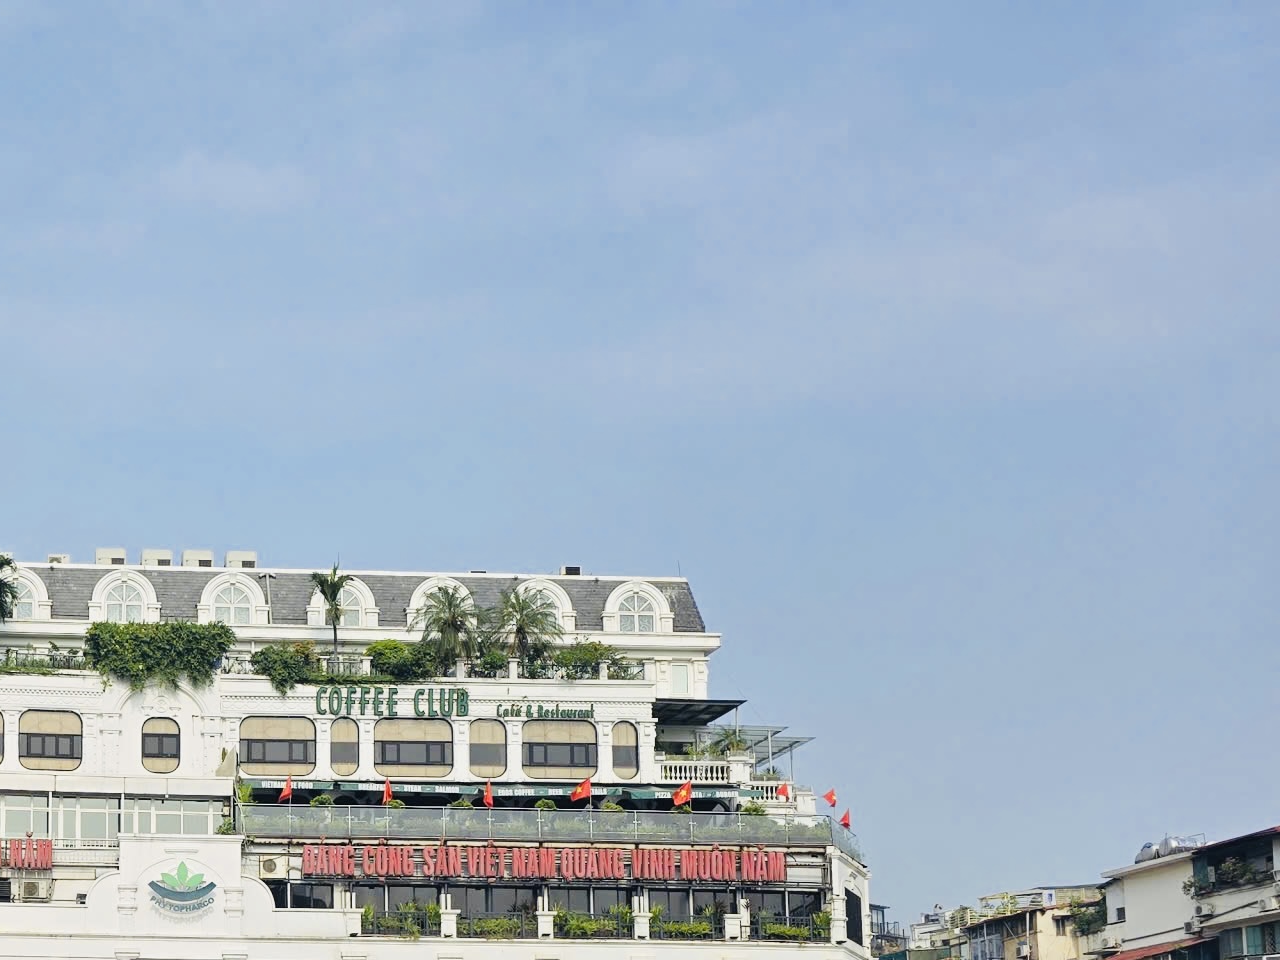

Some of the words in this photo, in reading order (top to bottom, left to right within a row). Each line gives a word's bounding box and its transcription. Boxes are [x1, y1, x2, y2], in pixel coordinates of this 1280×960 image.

[316, 687, 398, 717] COFFEE
[414, 688, 470, 717] CLUB
[526, 704, 534, 718] &
[538, 703, 595, 718] Restaurant
[261, 780, 297, 789] VIETNAMSE
[512, 847, 556, 879] NAM
[560, 847, 625, 881] QUANG
[631, 848, 676, 880] VINH
[150, 895, 215, 912] PHYTOPHARCO
